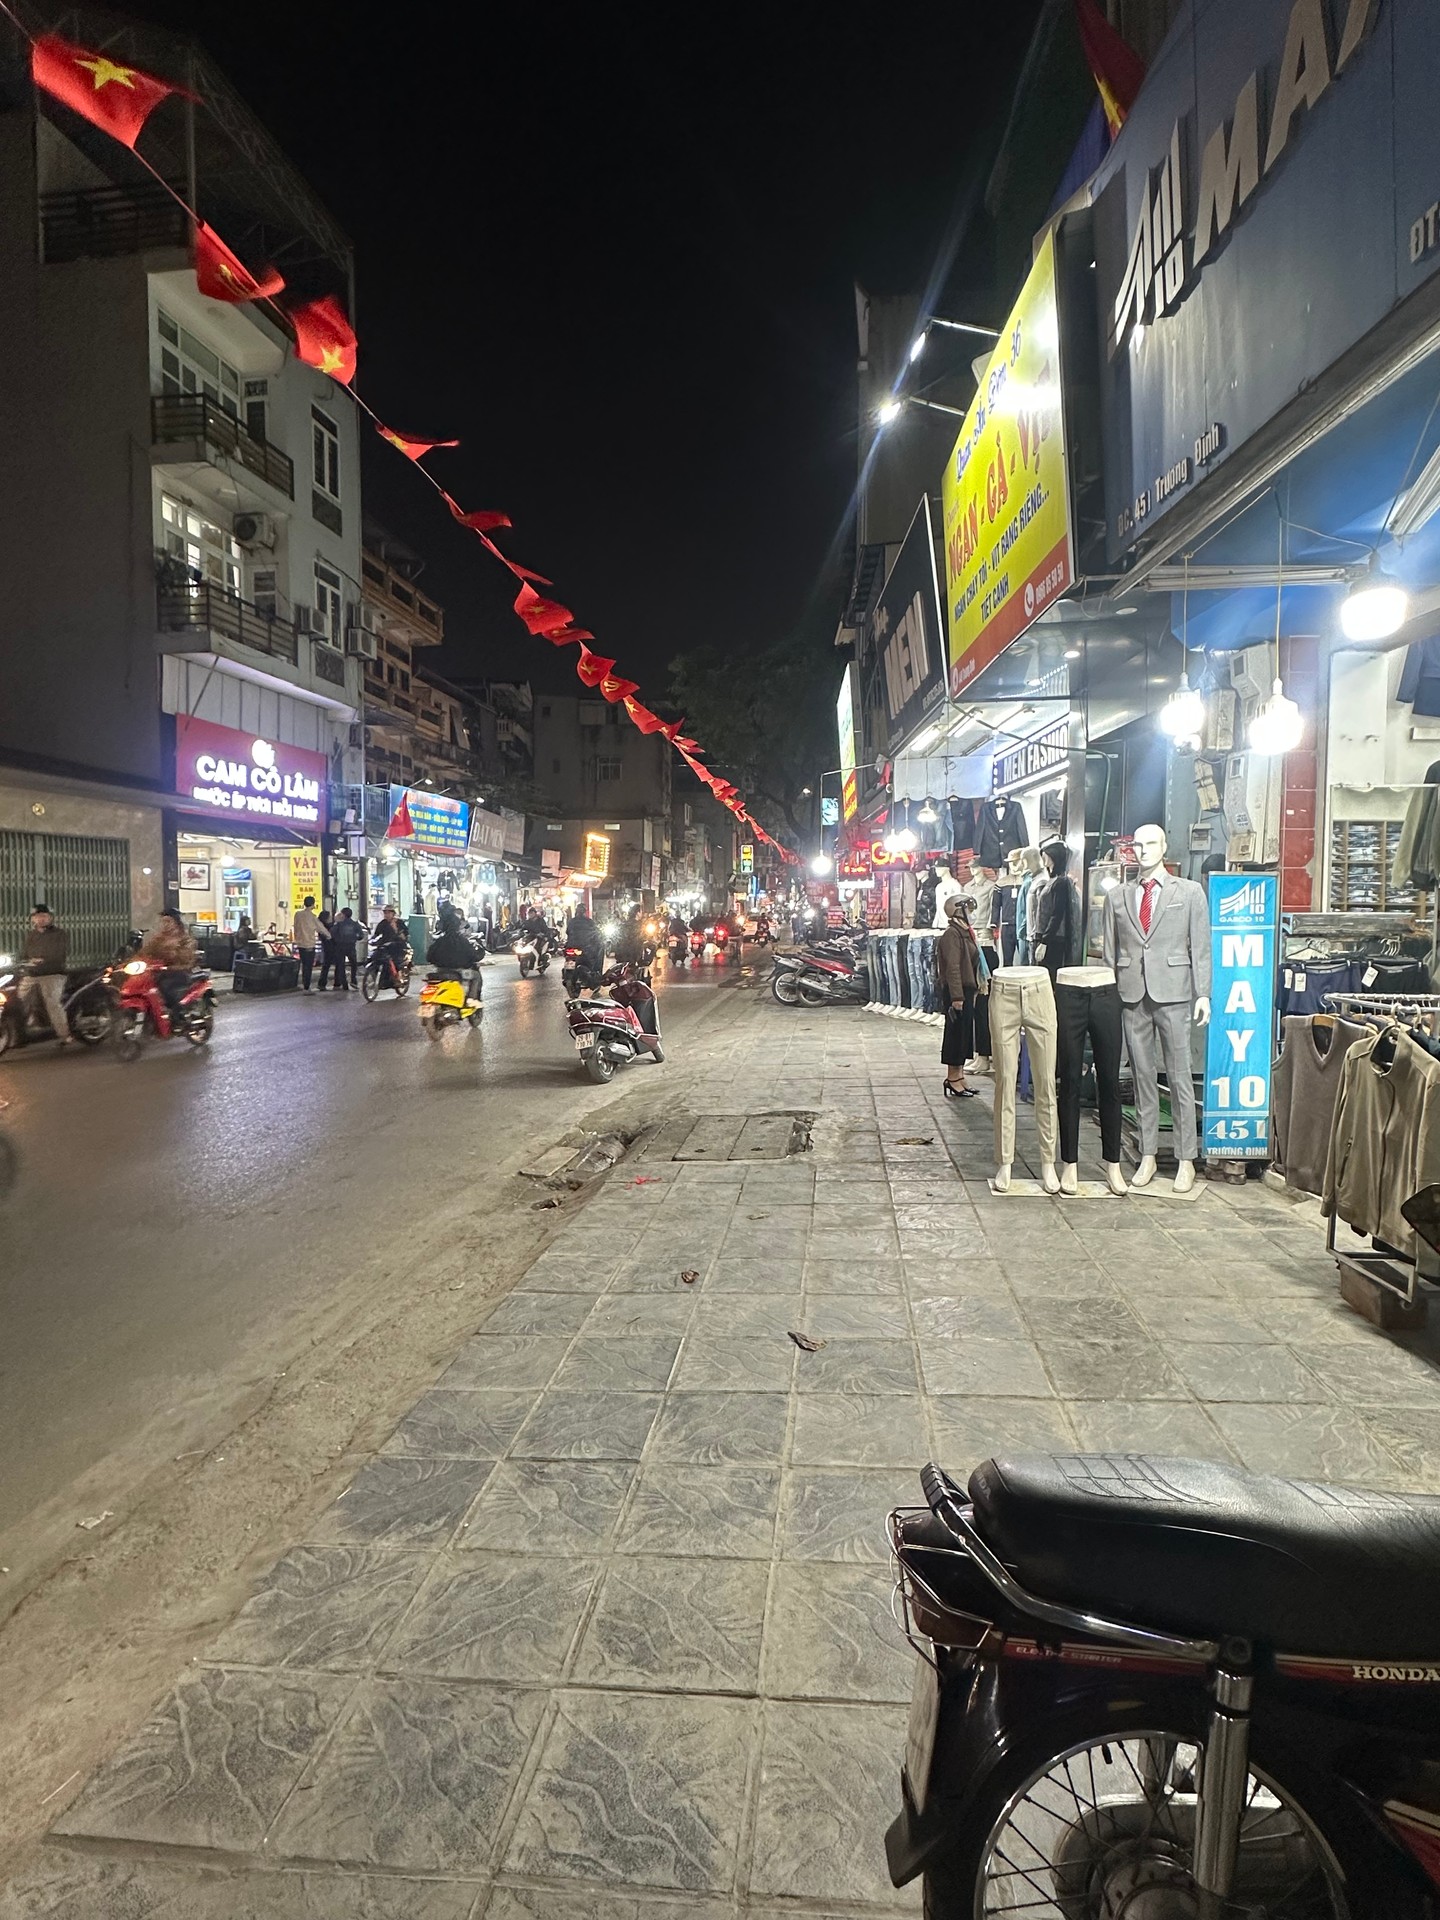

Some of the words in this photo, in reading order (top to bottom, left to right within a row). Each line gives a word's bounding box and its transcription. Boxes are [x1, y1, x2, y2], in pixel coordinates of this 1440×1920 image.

[1011, 319, 1022, 368] 36
[1134, 489, 1151, 521] 451
[1194, 423, 1220, 466] Định
[949, 491, 979, 590] NGAN
[986, 430, 1009, 524] GÀ
[1001, 516, 1019, 558] RANG
[993, 572, 1010, 608] CANH
[884, 590, 929, 721] MEN
[196, 755, 248, 788] CAM
[283, 772, 319, 802] LÂM
[1003, 743, 1027, 785] MEN
[1221, 934, 1264, 1063] MAY
[1210, 1075, 1266, 1108] 10
[1207, 1120, 1268, 1140] 451
[1352, 1665, 1440, 1681] HONDA
